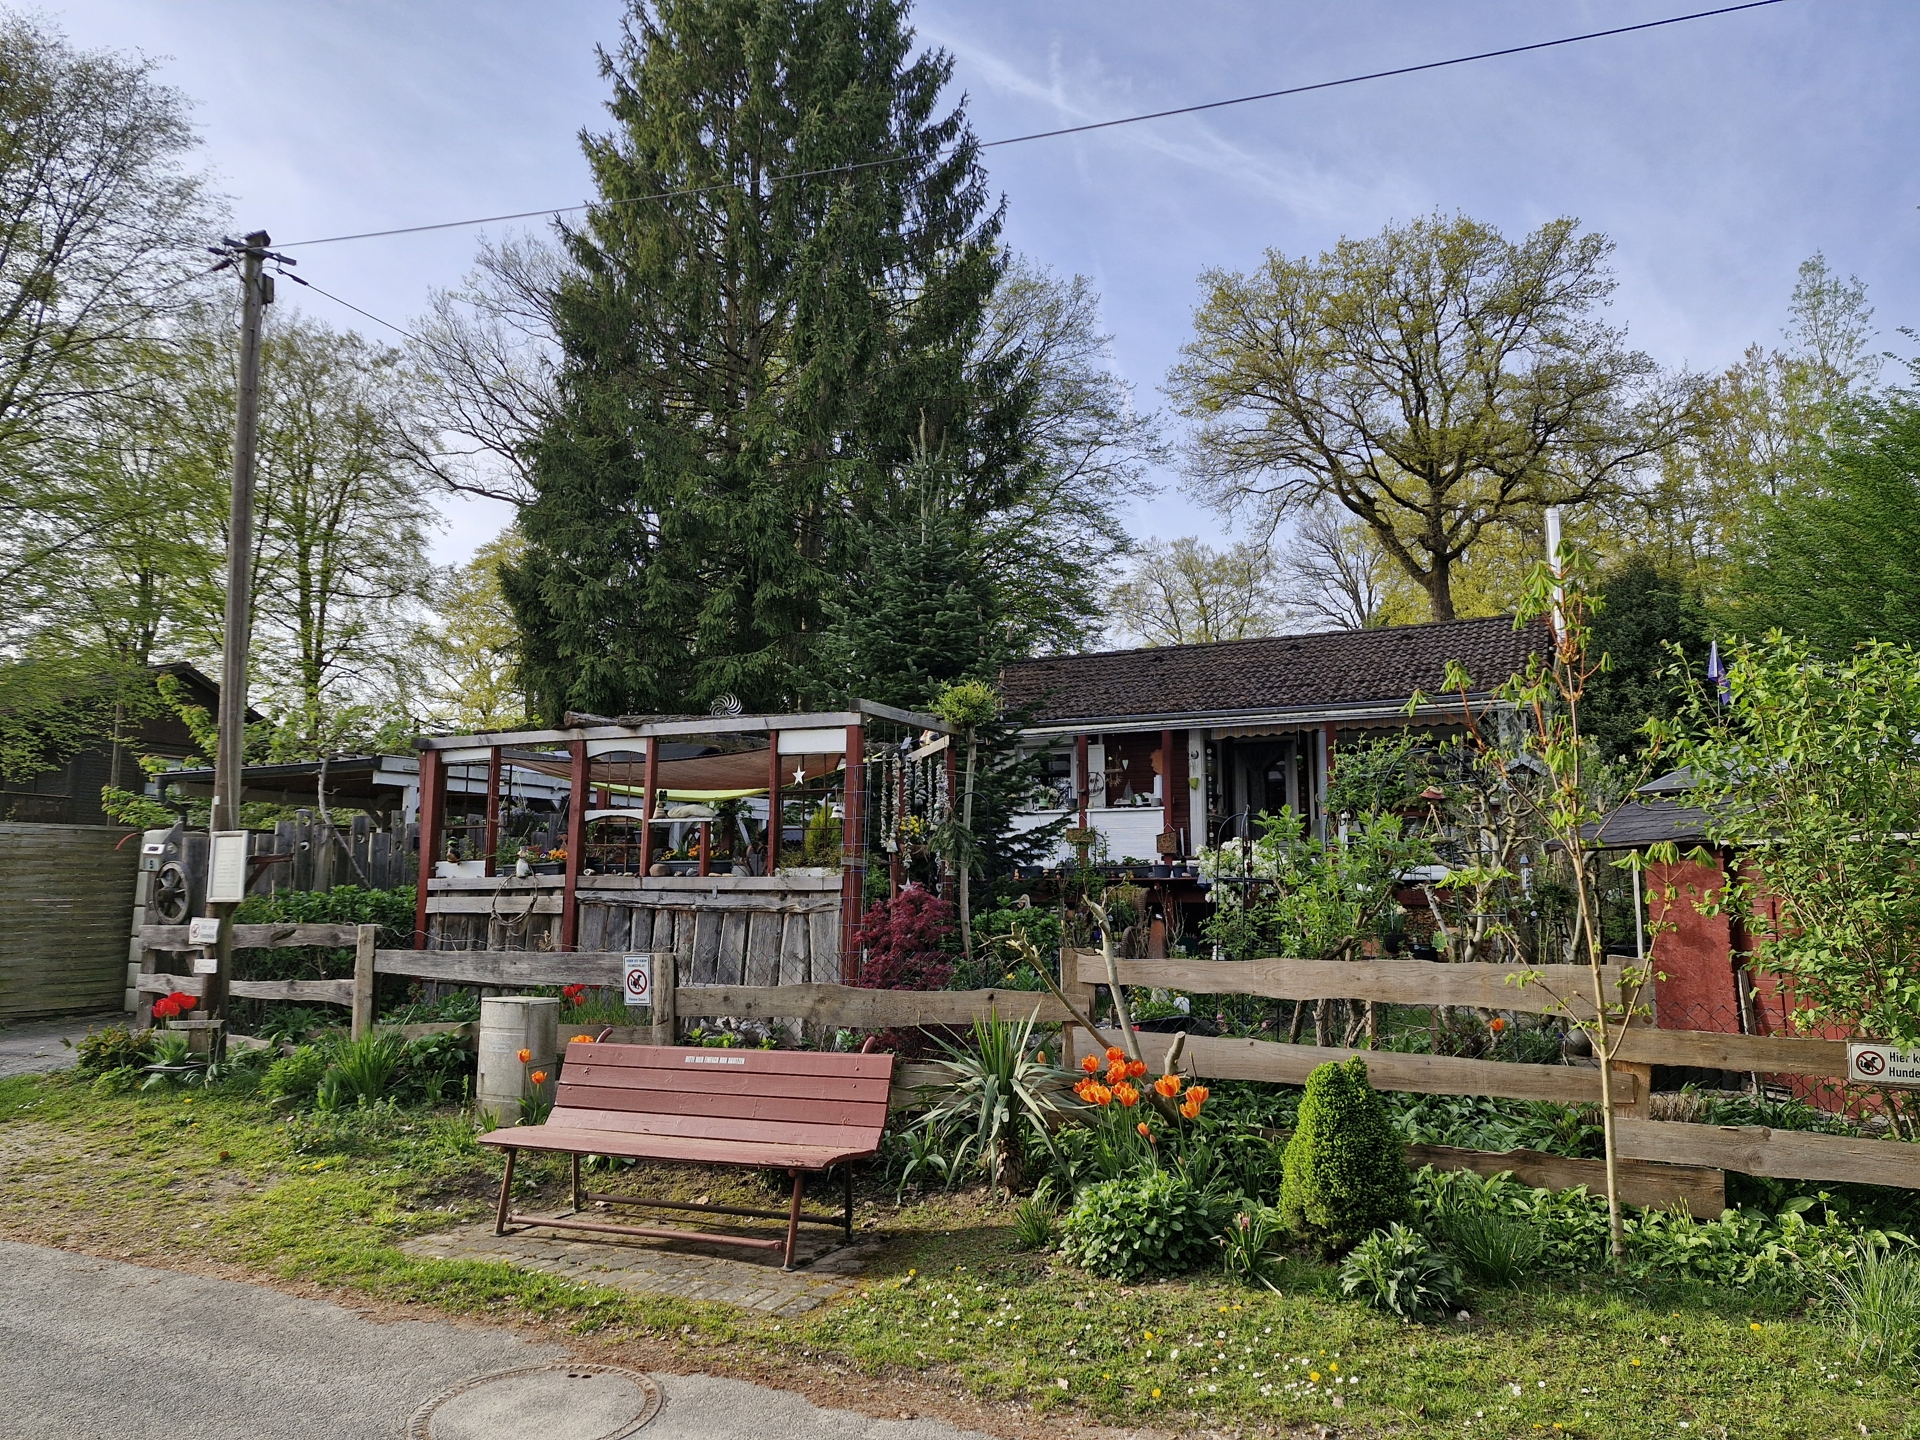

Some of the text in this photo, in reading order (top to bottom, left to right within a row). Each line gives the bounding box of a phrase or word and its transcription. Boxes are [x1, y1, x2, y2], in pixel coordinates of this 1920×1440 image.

[149, 860, 154, 869] 5
[1889, 1052, 1910, 1063] Hier
[1889, 1066, 1920, 1078] Hunde
